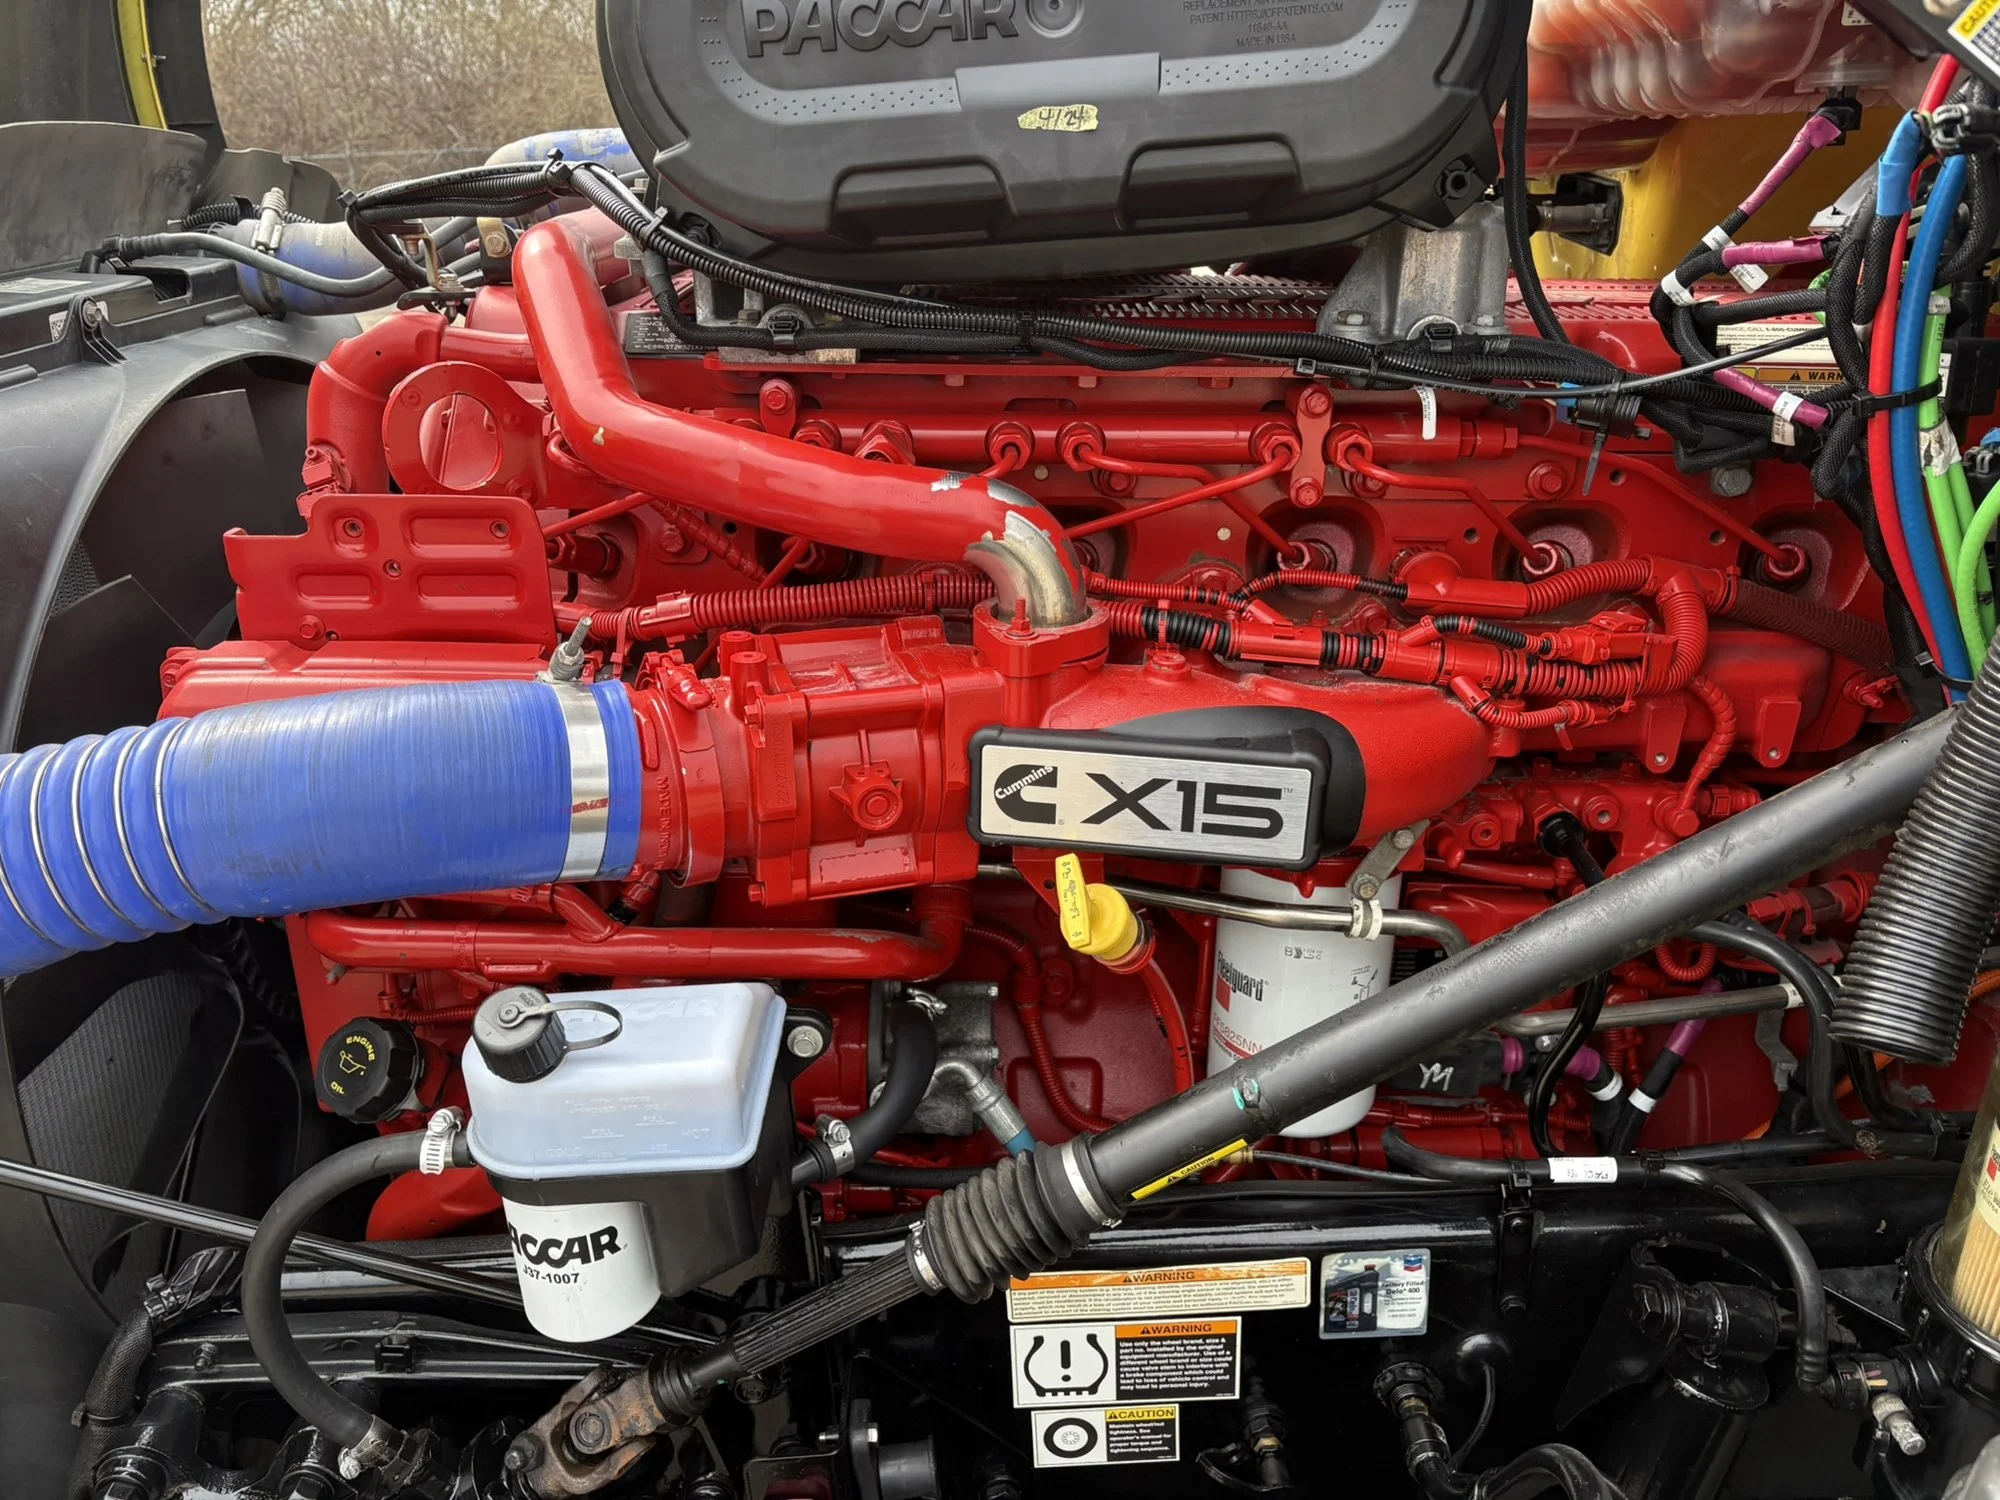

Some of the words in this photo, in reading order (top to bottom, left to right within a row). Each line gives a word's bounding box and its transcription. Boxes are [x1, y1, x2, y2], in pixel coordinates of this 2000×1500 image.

[1189, 12, 1225, 24] PATENT
[742, 0, 1019, 57] PACCAR
[1236, 36, 1264, 48] MADE
[1265, 34, 1275, 45] IN
[1277, 32, 1297, 44] USA
[994, 764, 1054, 800] Cummins
[657, 776, 672, 816] MADE
[1080, 772, 1284, 839] X15
[1217, 949, 1265, 1002] Fleetguard
[346, 1035, 376, 1061] ENGINE
[330, 1081, 345, 1095] OIL
[680, 1128, 711, 1140] HOT
[545, 1146, 583, 1159] COLD
[1180, 1156, 1215, 1175] CAUTION
[509, 1222, 622, 1269] ACCAR
[1132, 1271, 1196, 1282] WARNING
[1151, 1323, 1212, 1334] WARNING
[1118, 1408, 1173, 1418] CAUTION
